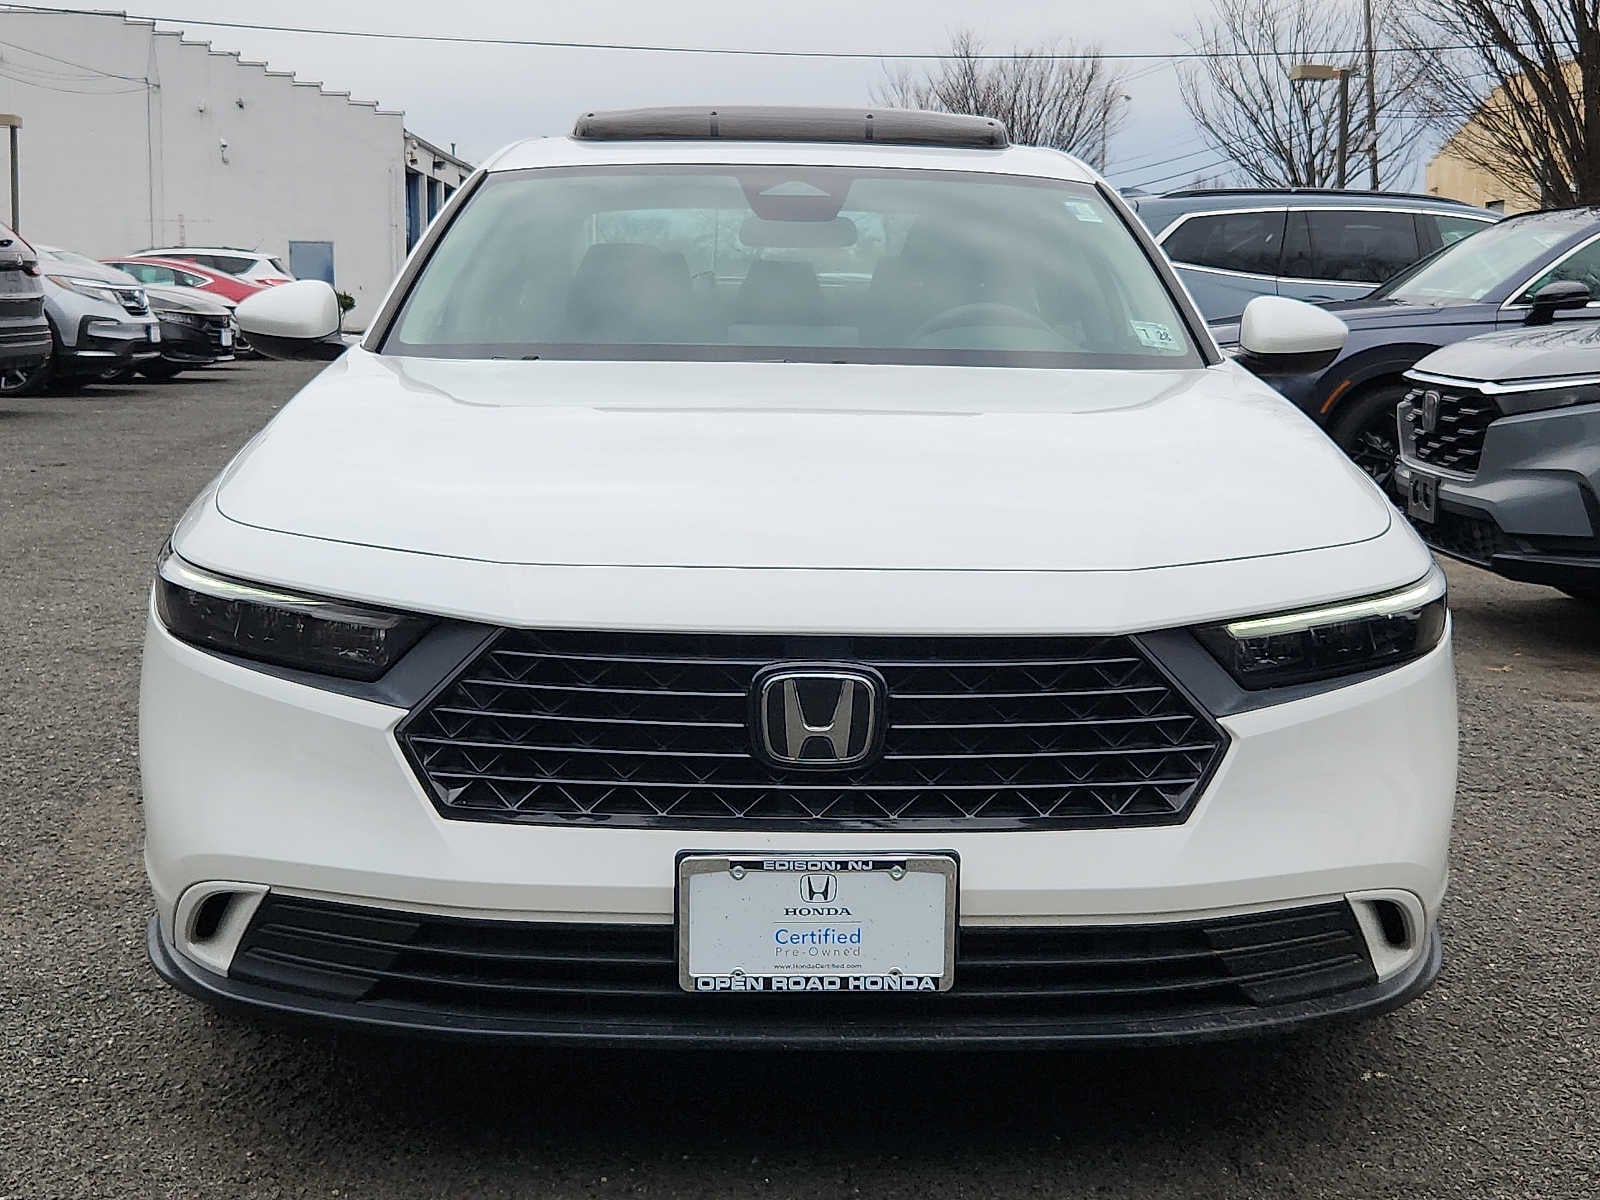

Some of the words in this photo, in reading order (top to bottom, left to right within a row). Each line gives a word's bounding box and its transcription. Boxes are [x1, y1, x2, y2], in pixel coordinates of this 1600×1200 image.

[763, 860, 840, 871] EDISON,
[848, 860, 873, 871] NJ
[784, 907, 852, 917] HONDA
[775, 928, 861, 945] Certified
[775, 946, 861, 957] Pre-Owned
[697, 976, 763, 991] OPEN
[771, 976, 841, 991] ROAD
[849, 976, 936, 991] HONDA
